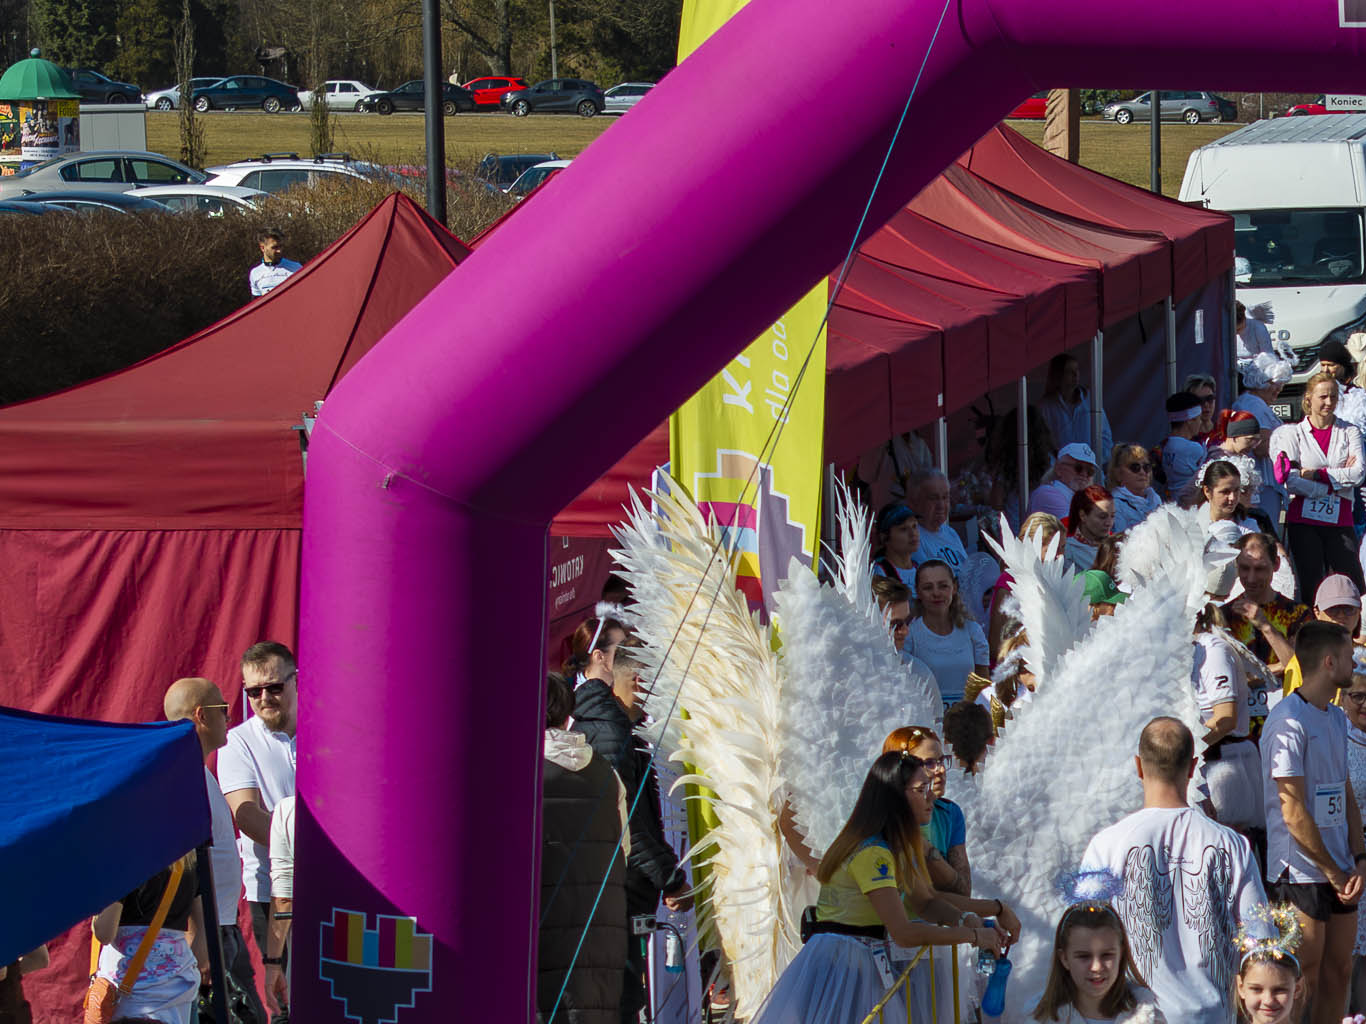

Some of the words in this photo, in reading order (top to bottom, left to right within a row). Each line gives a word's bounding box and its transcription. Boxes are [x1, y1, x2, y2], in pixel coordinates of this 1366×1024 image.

[1331, 97, 1363, 106] Koniec
[765, 369, 790, 424] dla
[1309, 501, 1335, 516] 178
[1327, 795, 1343, 815] 53
